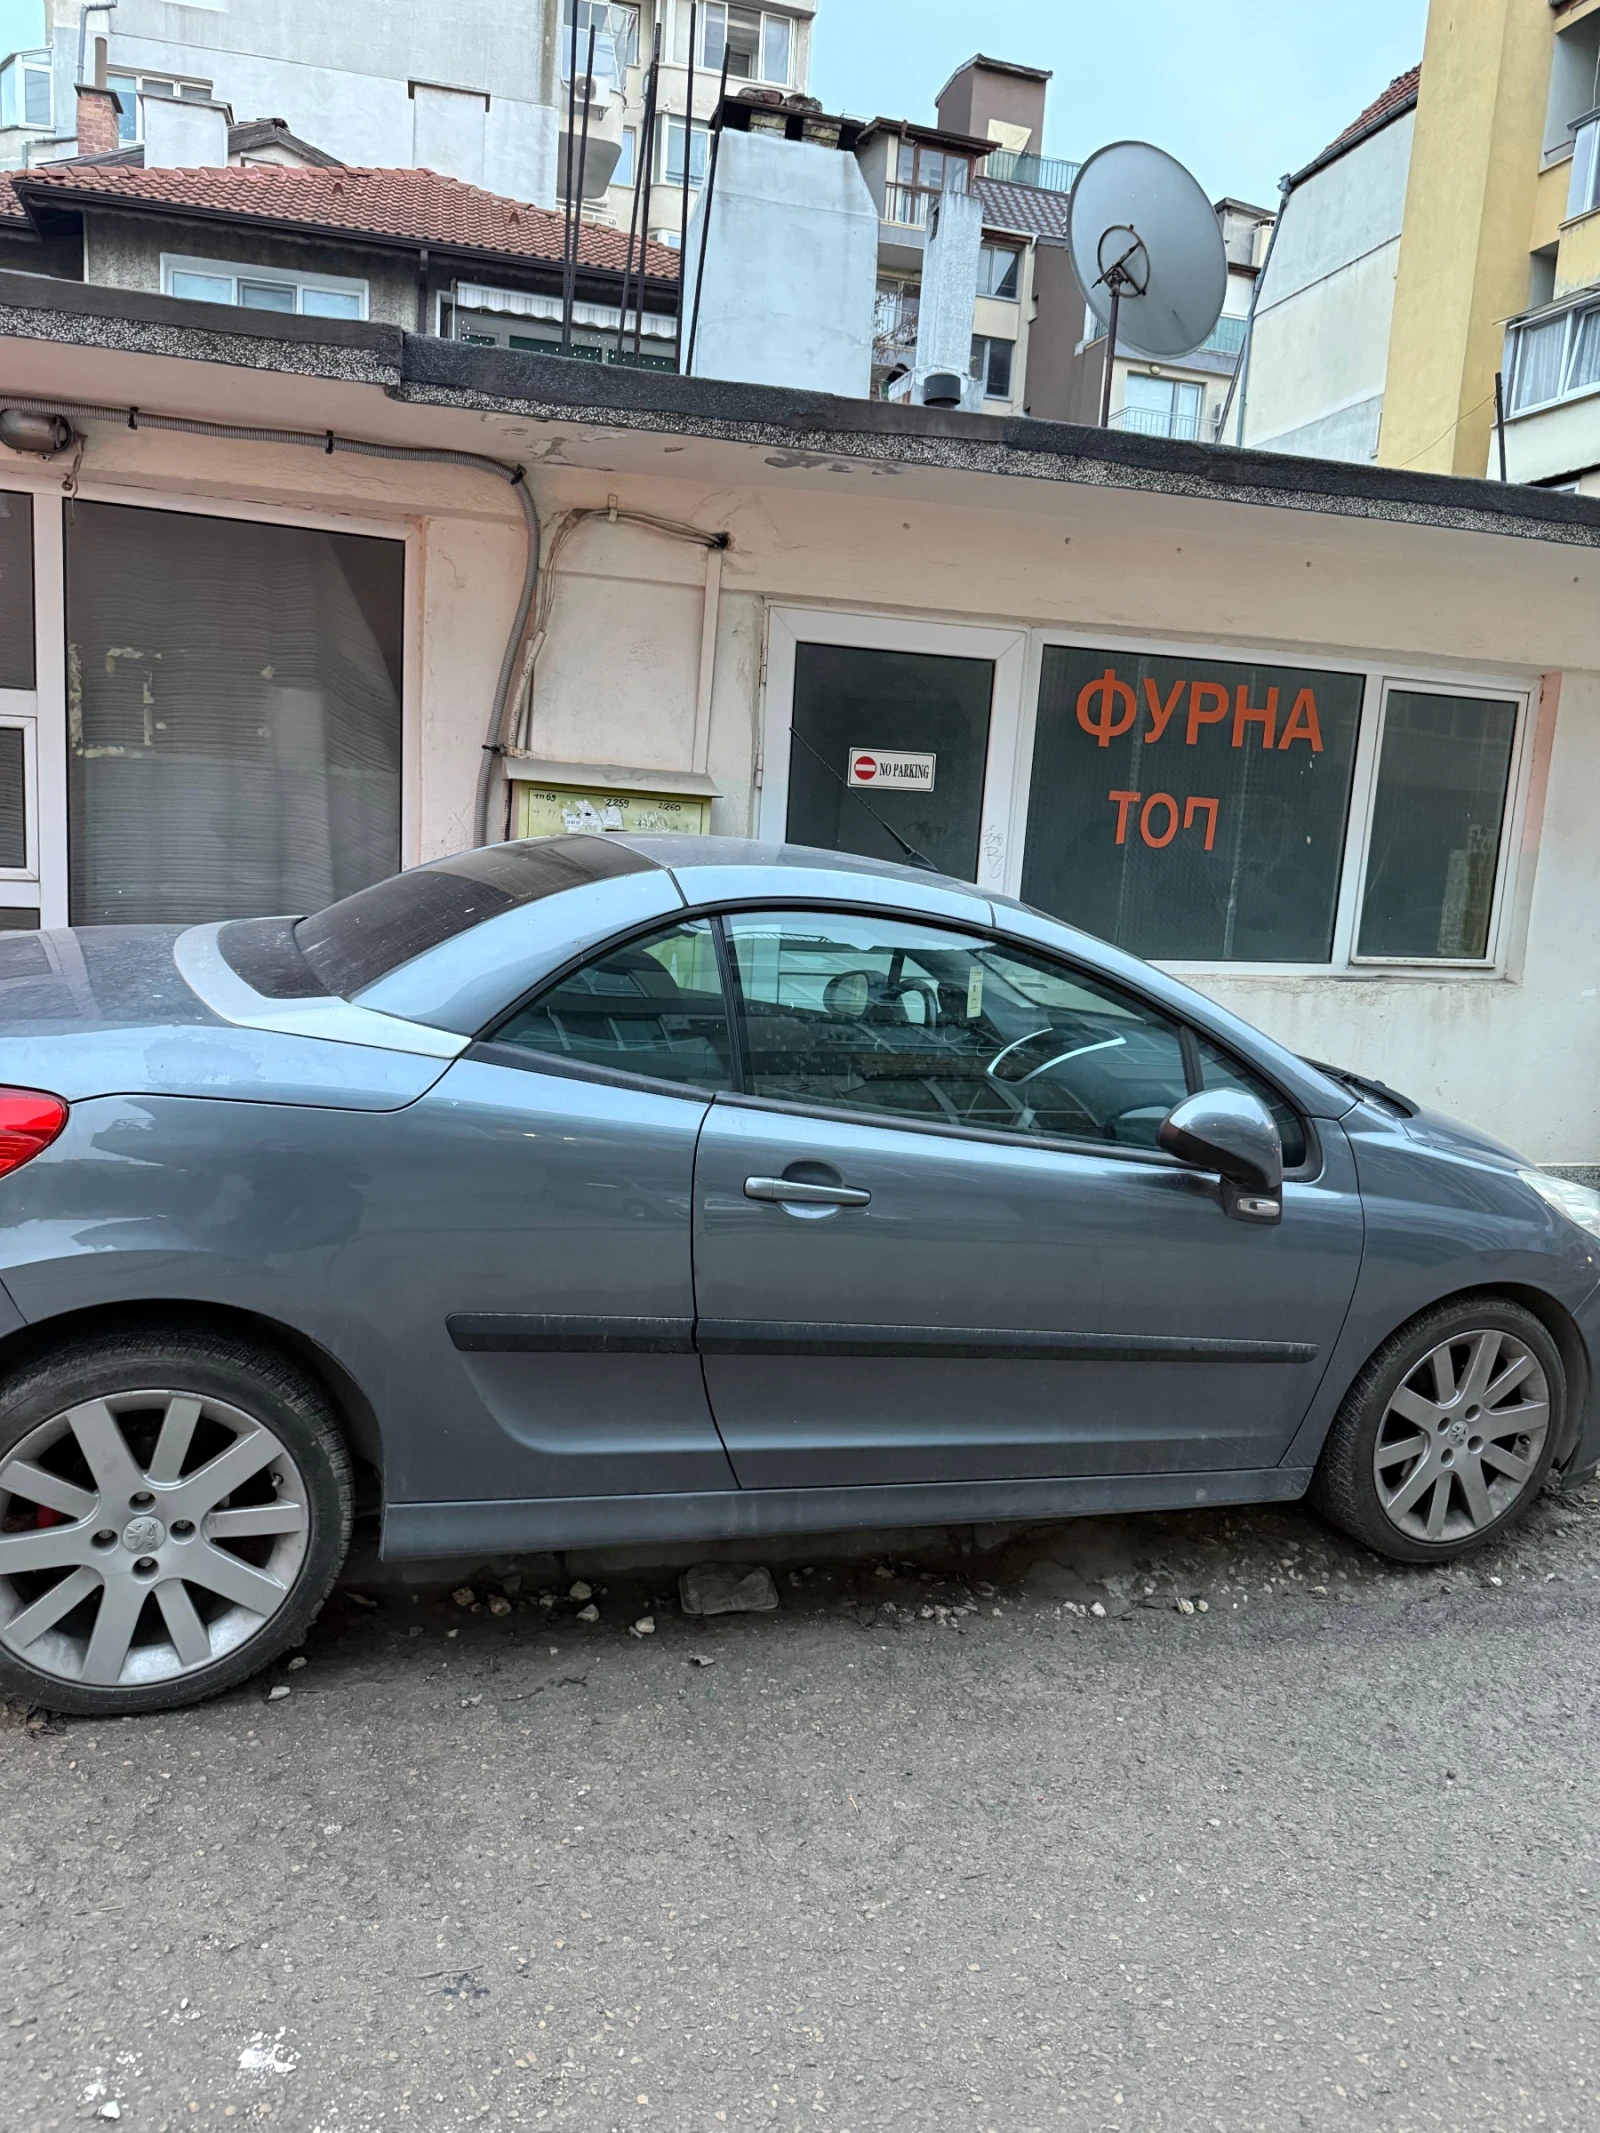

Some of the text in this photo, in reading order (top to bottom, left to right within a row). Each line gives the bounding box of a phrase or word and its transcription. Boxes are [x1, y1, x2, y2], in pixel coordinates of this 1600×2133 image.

[1076, 669, 1324, 751] ФУРНА
[879, 763, 930, 779] NO PARKING
[1109, 790, 1219, 851] ТОП
